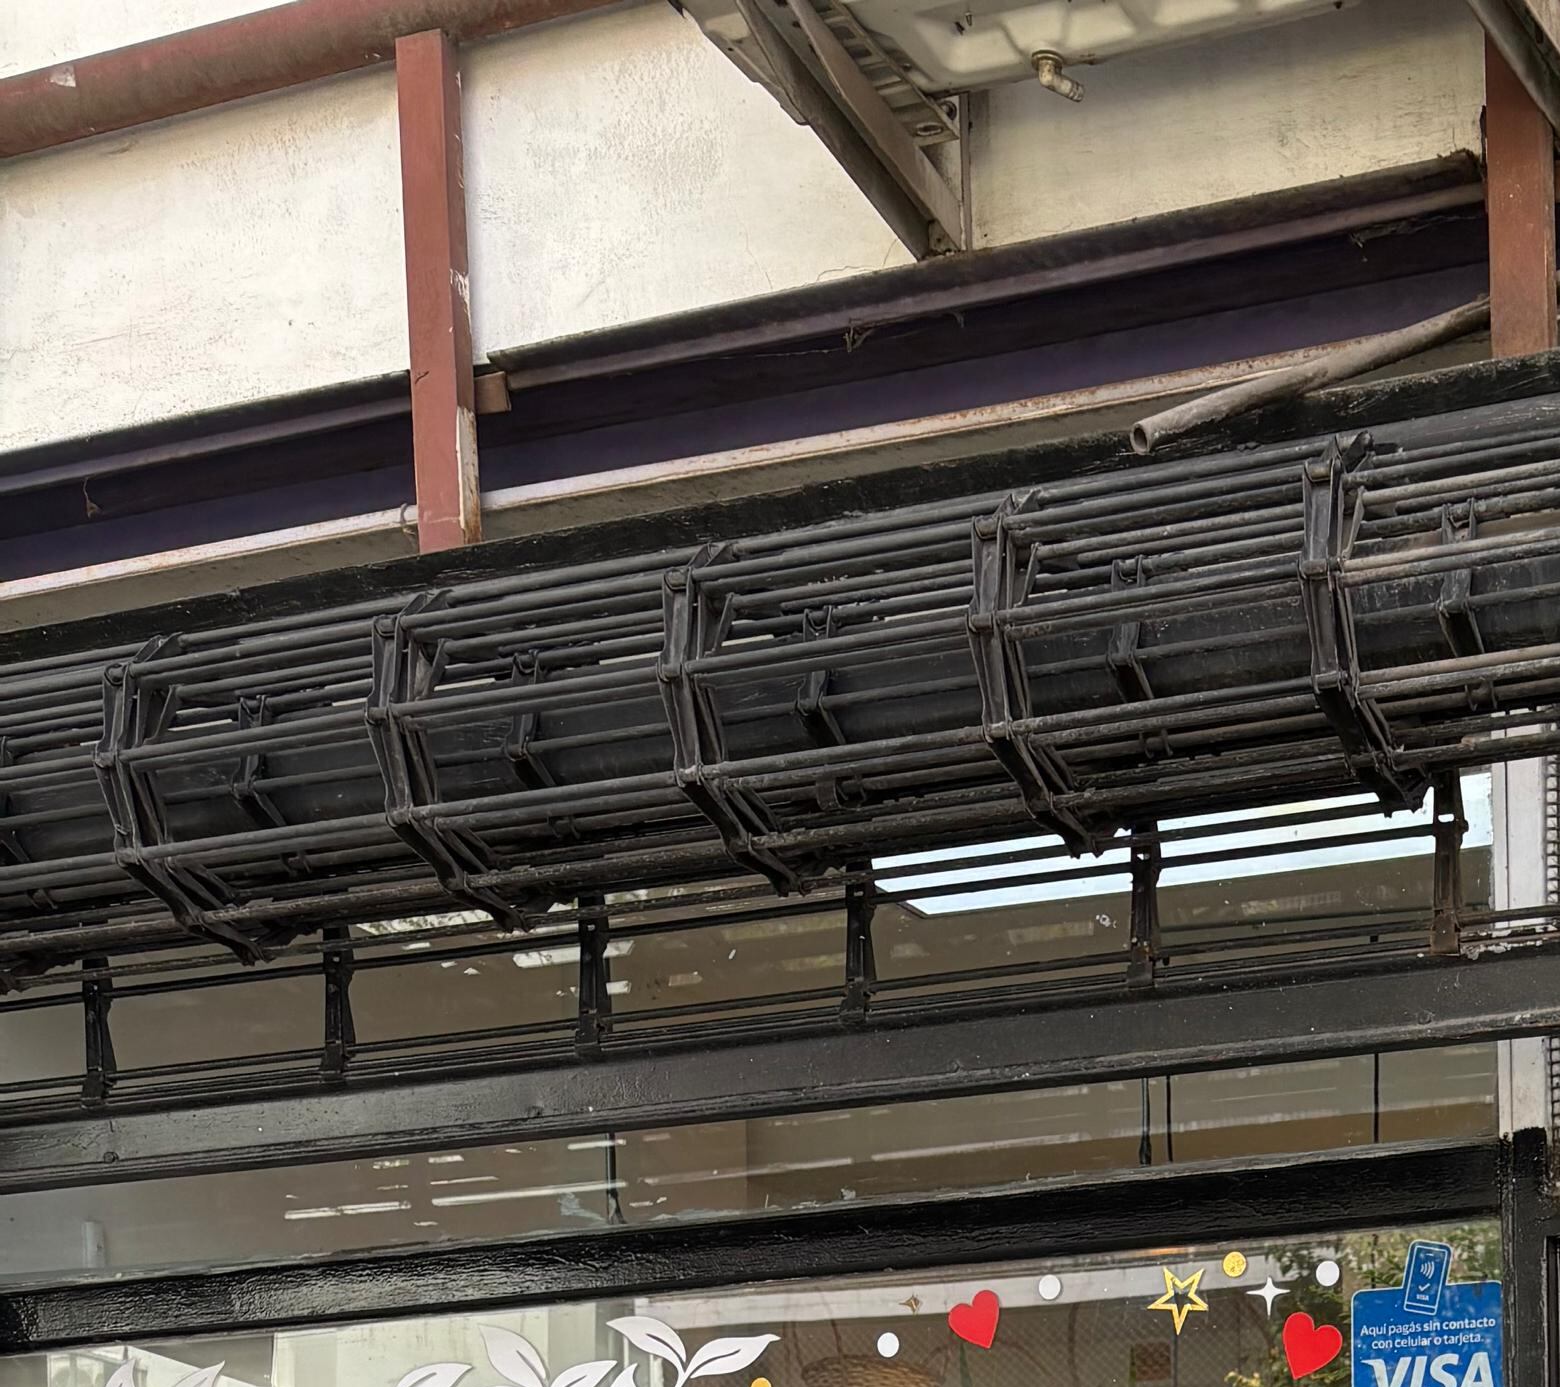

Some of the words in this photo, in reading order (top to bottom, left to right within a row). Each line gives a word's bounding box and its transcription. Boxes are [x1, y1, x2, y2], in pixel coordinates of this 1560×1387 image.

[1360, 1323, 1387, 1337] Aquí
[1388, 1320, 1422, 1336] pagás
[1423, 1320, 1441, 1332] sin
[1442, 1317, 1496, 1331] contacto
[1371, 1338, 1393, 1350] con
[1394, 1334, 1432, 1348] celular
[1433, 1336, 1442, 1346] o
